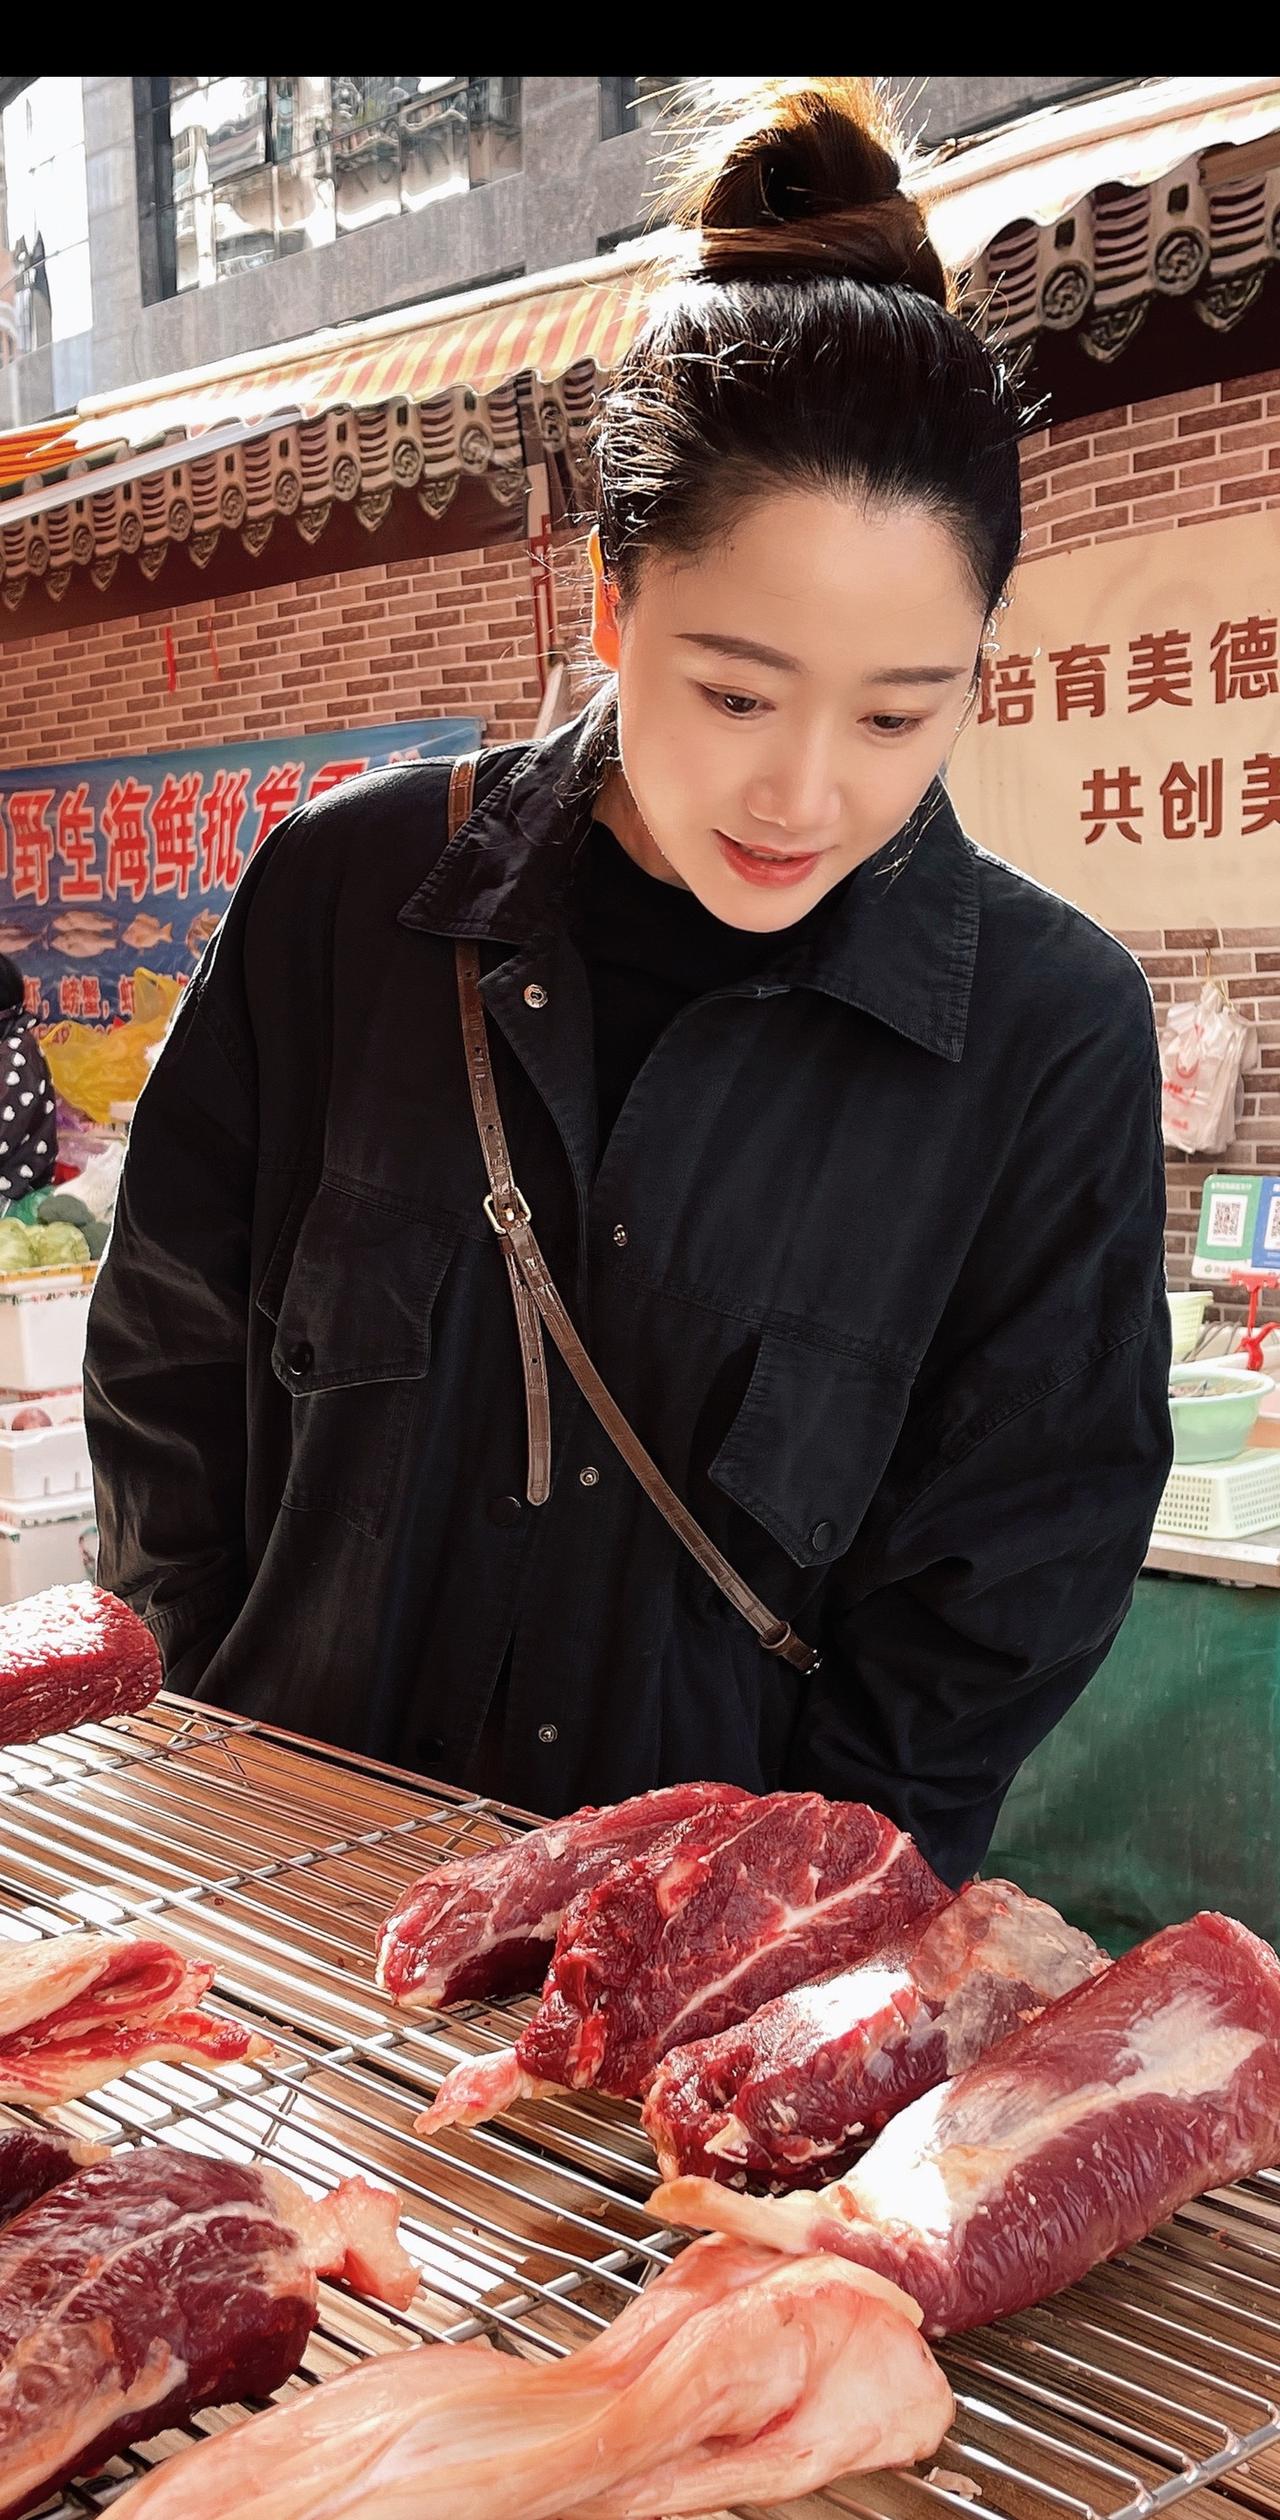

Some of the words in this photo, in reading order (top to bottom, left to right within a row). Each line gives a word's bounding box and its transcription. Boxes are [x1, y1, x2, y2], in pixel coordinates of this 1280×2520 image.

[977, 615, 1280, 727] 培育美德
[1080, 752, 1280, 845] 共创美
